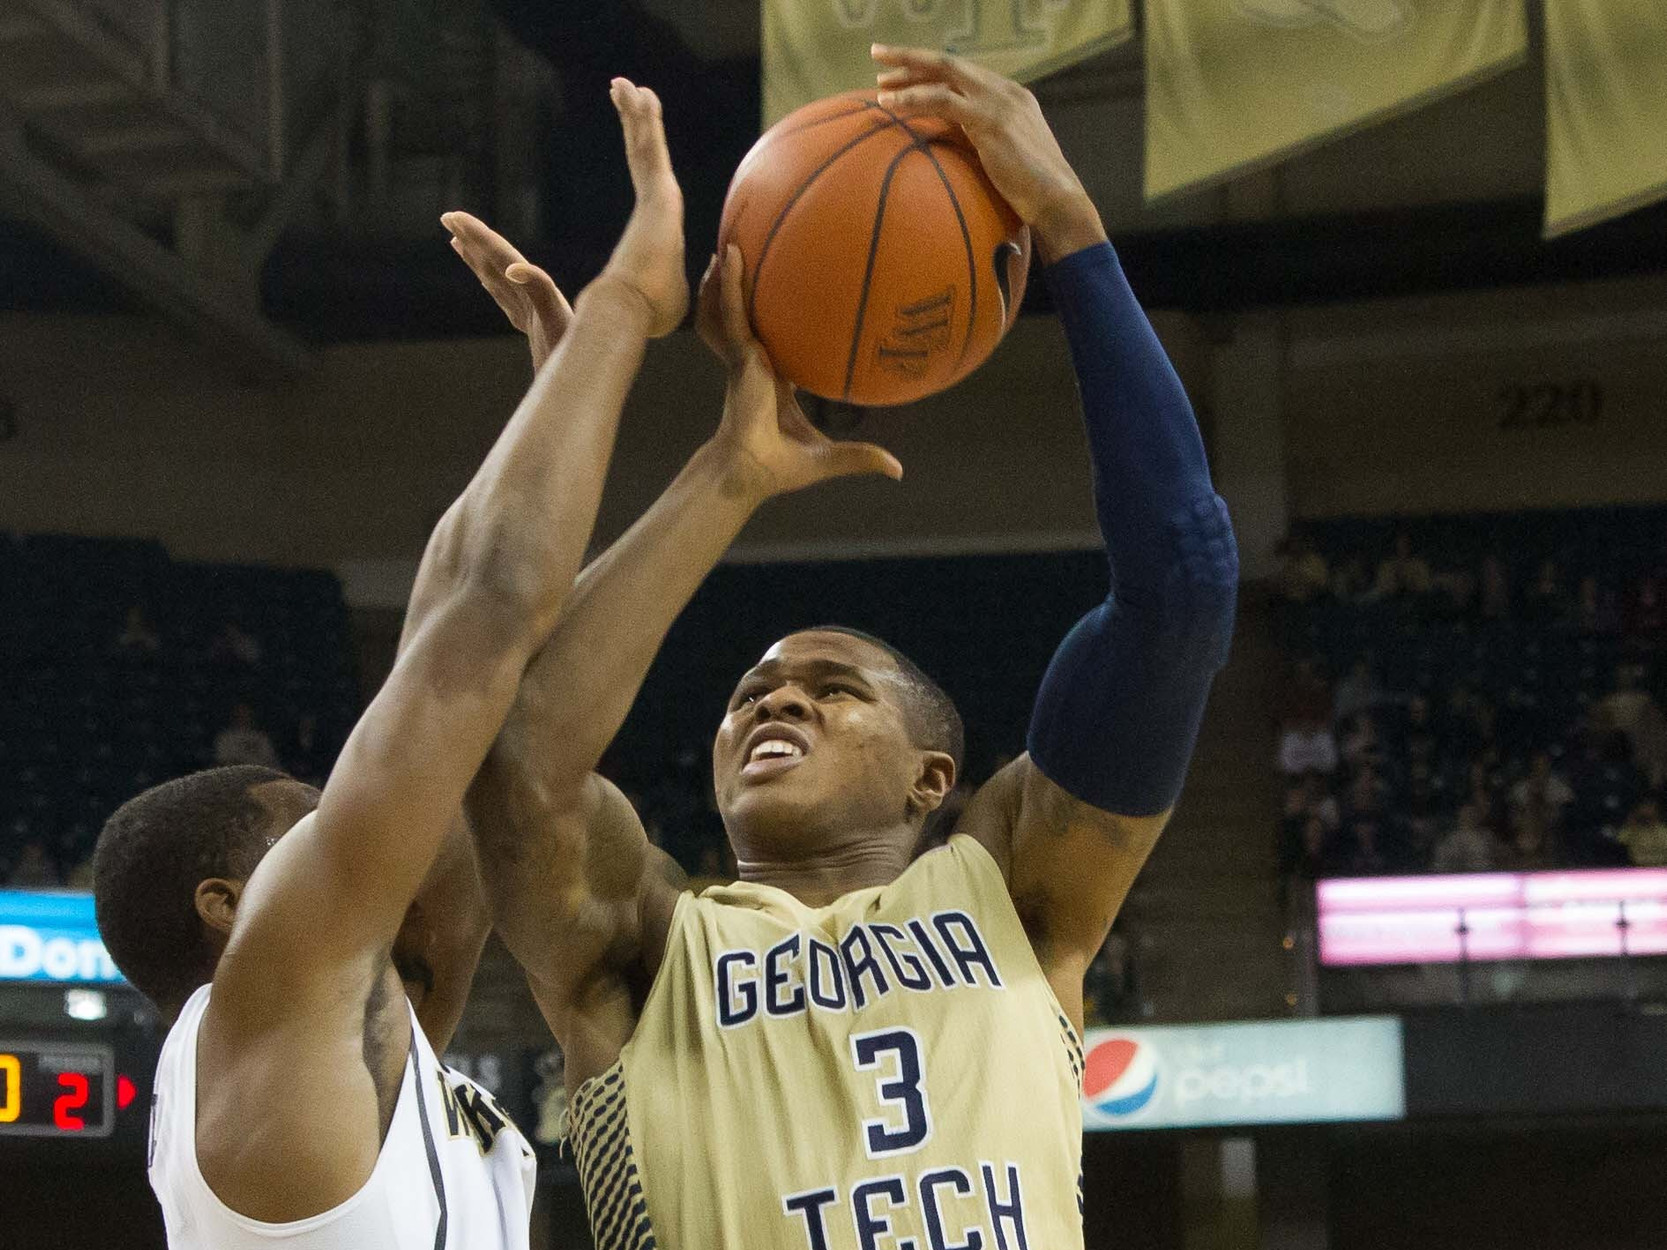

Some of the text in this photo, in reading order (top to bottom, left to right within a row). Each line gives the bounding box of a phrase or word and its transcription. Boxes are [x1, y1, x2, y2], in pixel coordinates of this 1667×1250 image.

[716, 910, 1005, 1029] GEORGIA
[53, 1072, 89, 1131] 2
[849, 1025, 934, 1160] 3
